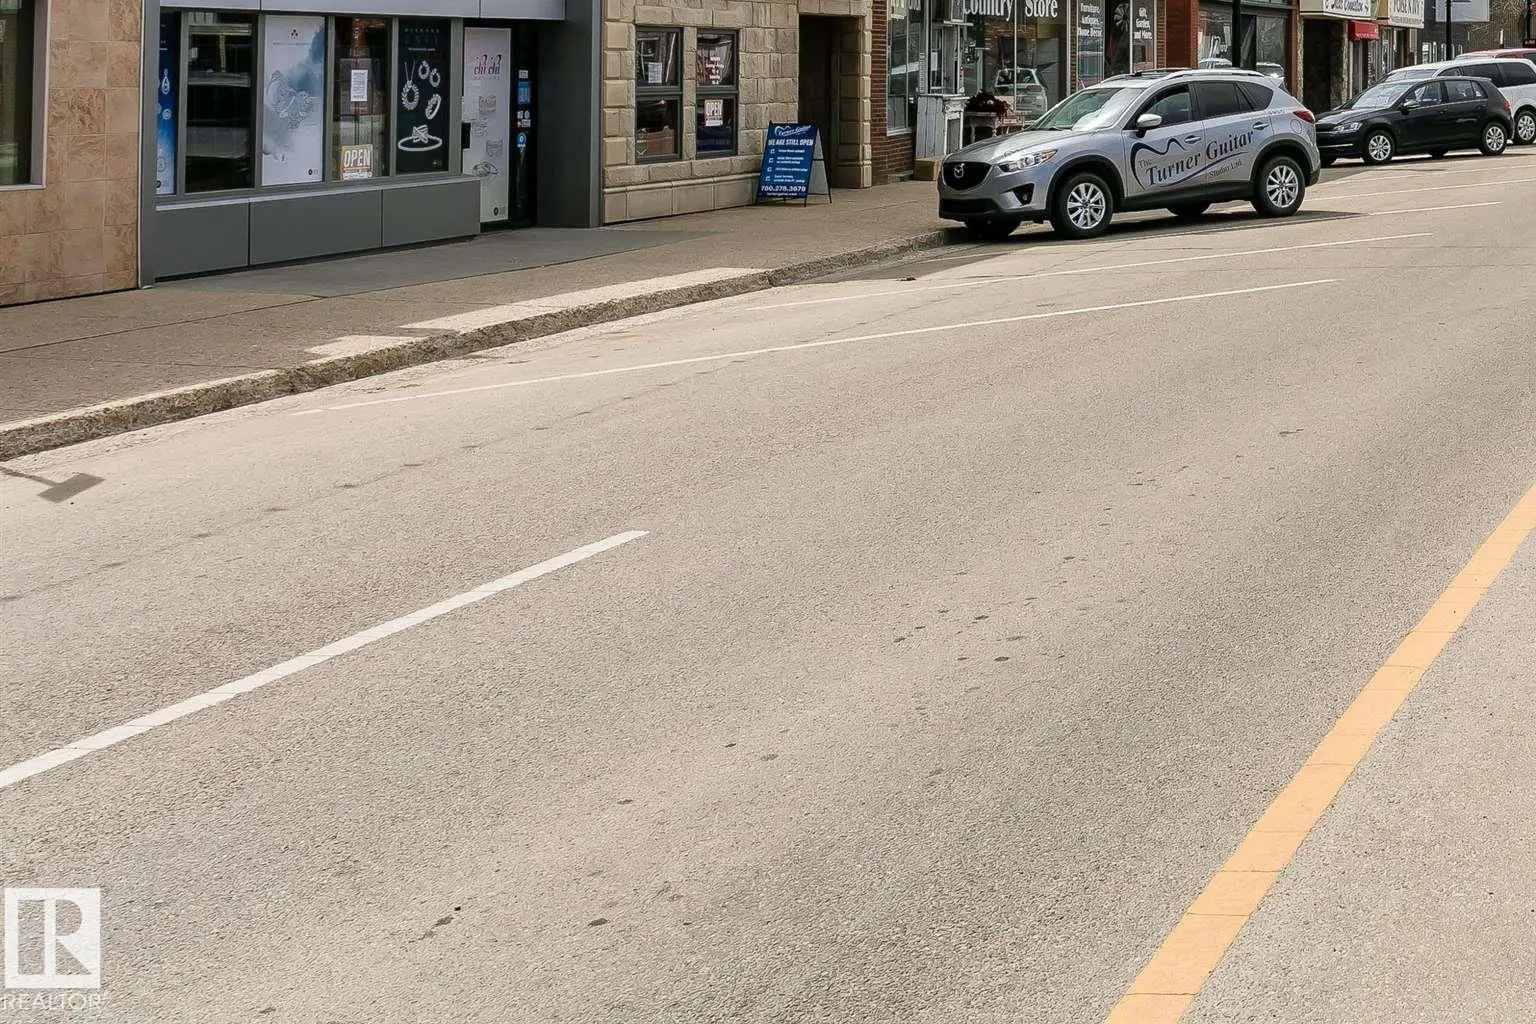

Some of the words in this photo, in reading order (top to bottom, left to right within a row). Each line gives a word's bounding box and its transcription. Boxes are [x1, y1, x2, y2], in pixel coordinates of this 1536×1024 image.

[799, 138, 814, 146] OPEN
[343, 149, 371, 167] OPEN
[1145, 152, 1201, 186] Turner
[1206, 129, 1255, 161] Guitar
